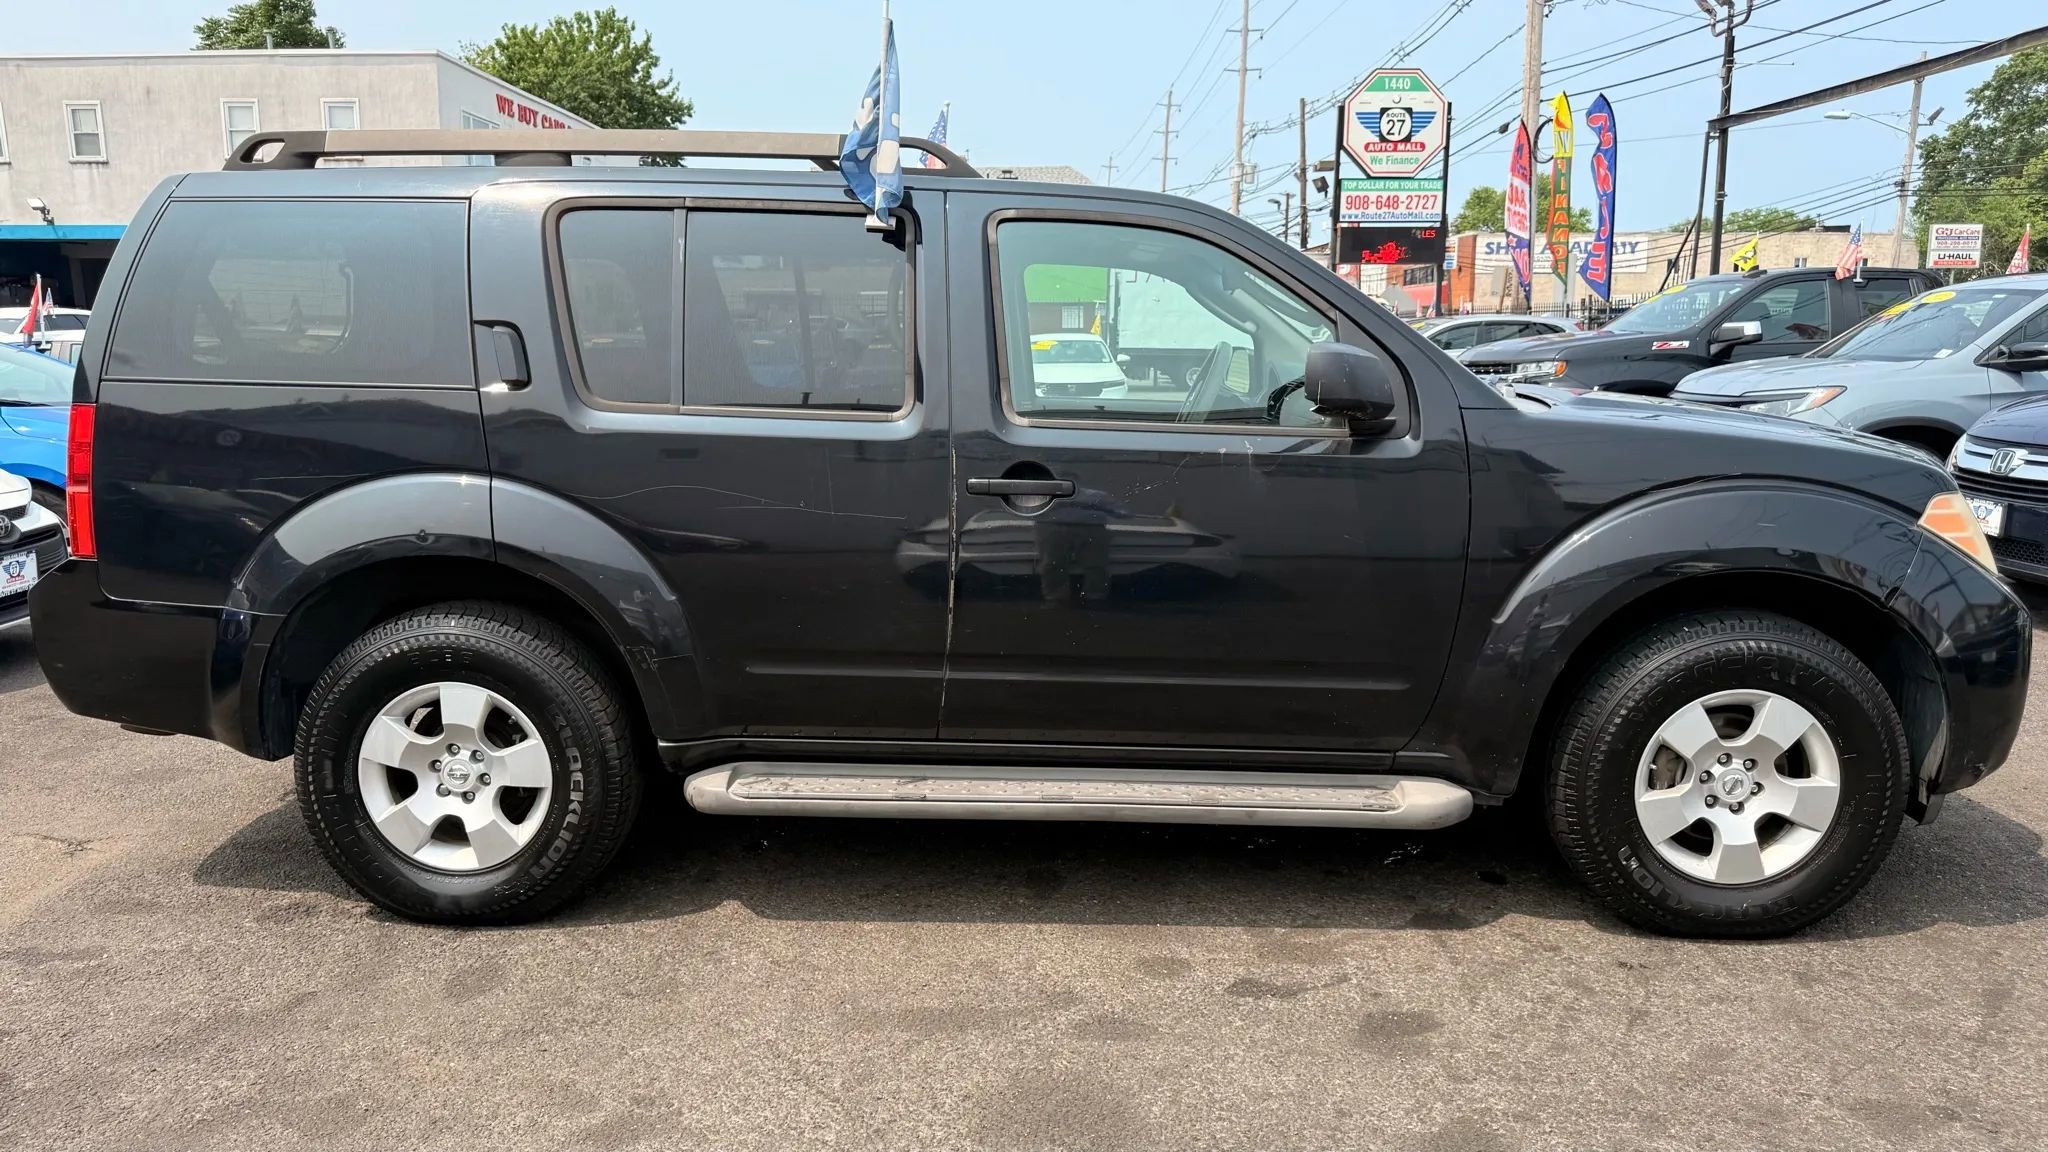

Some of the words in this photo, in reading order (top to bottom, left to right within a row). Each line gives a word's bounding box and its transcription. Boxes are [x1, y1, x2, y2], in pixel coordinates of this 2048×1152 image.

[1384, 78, 1411, 90] 1440
[496, 94, 515, 118] WE
[517, 104, 539, 128] BUY
[1386, 119, 1406, 136] 27
[1367, 142, 1394, 151] AUTO
[1397, 142, 1423, 151] MALL
[1370, 155, 1384, 165] We
[1386, 155, 1420, 165] Finance
[1344, 181, 1358, 190] TOP
[1359, 181, 1385, 190] DOLLAR
[1386, 181, 1399, 190] FOR
[1401, 181, 1419, 190] YOUR
[1420, 181, 1442, 190] TRADE
[1345, 195, 1438, 210] 908-648-2727
[1341, 211, 1441, 220] www.Route27AutoMall.com
